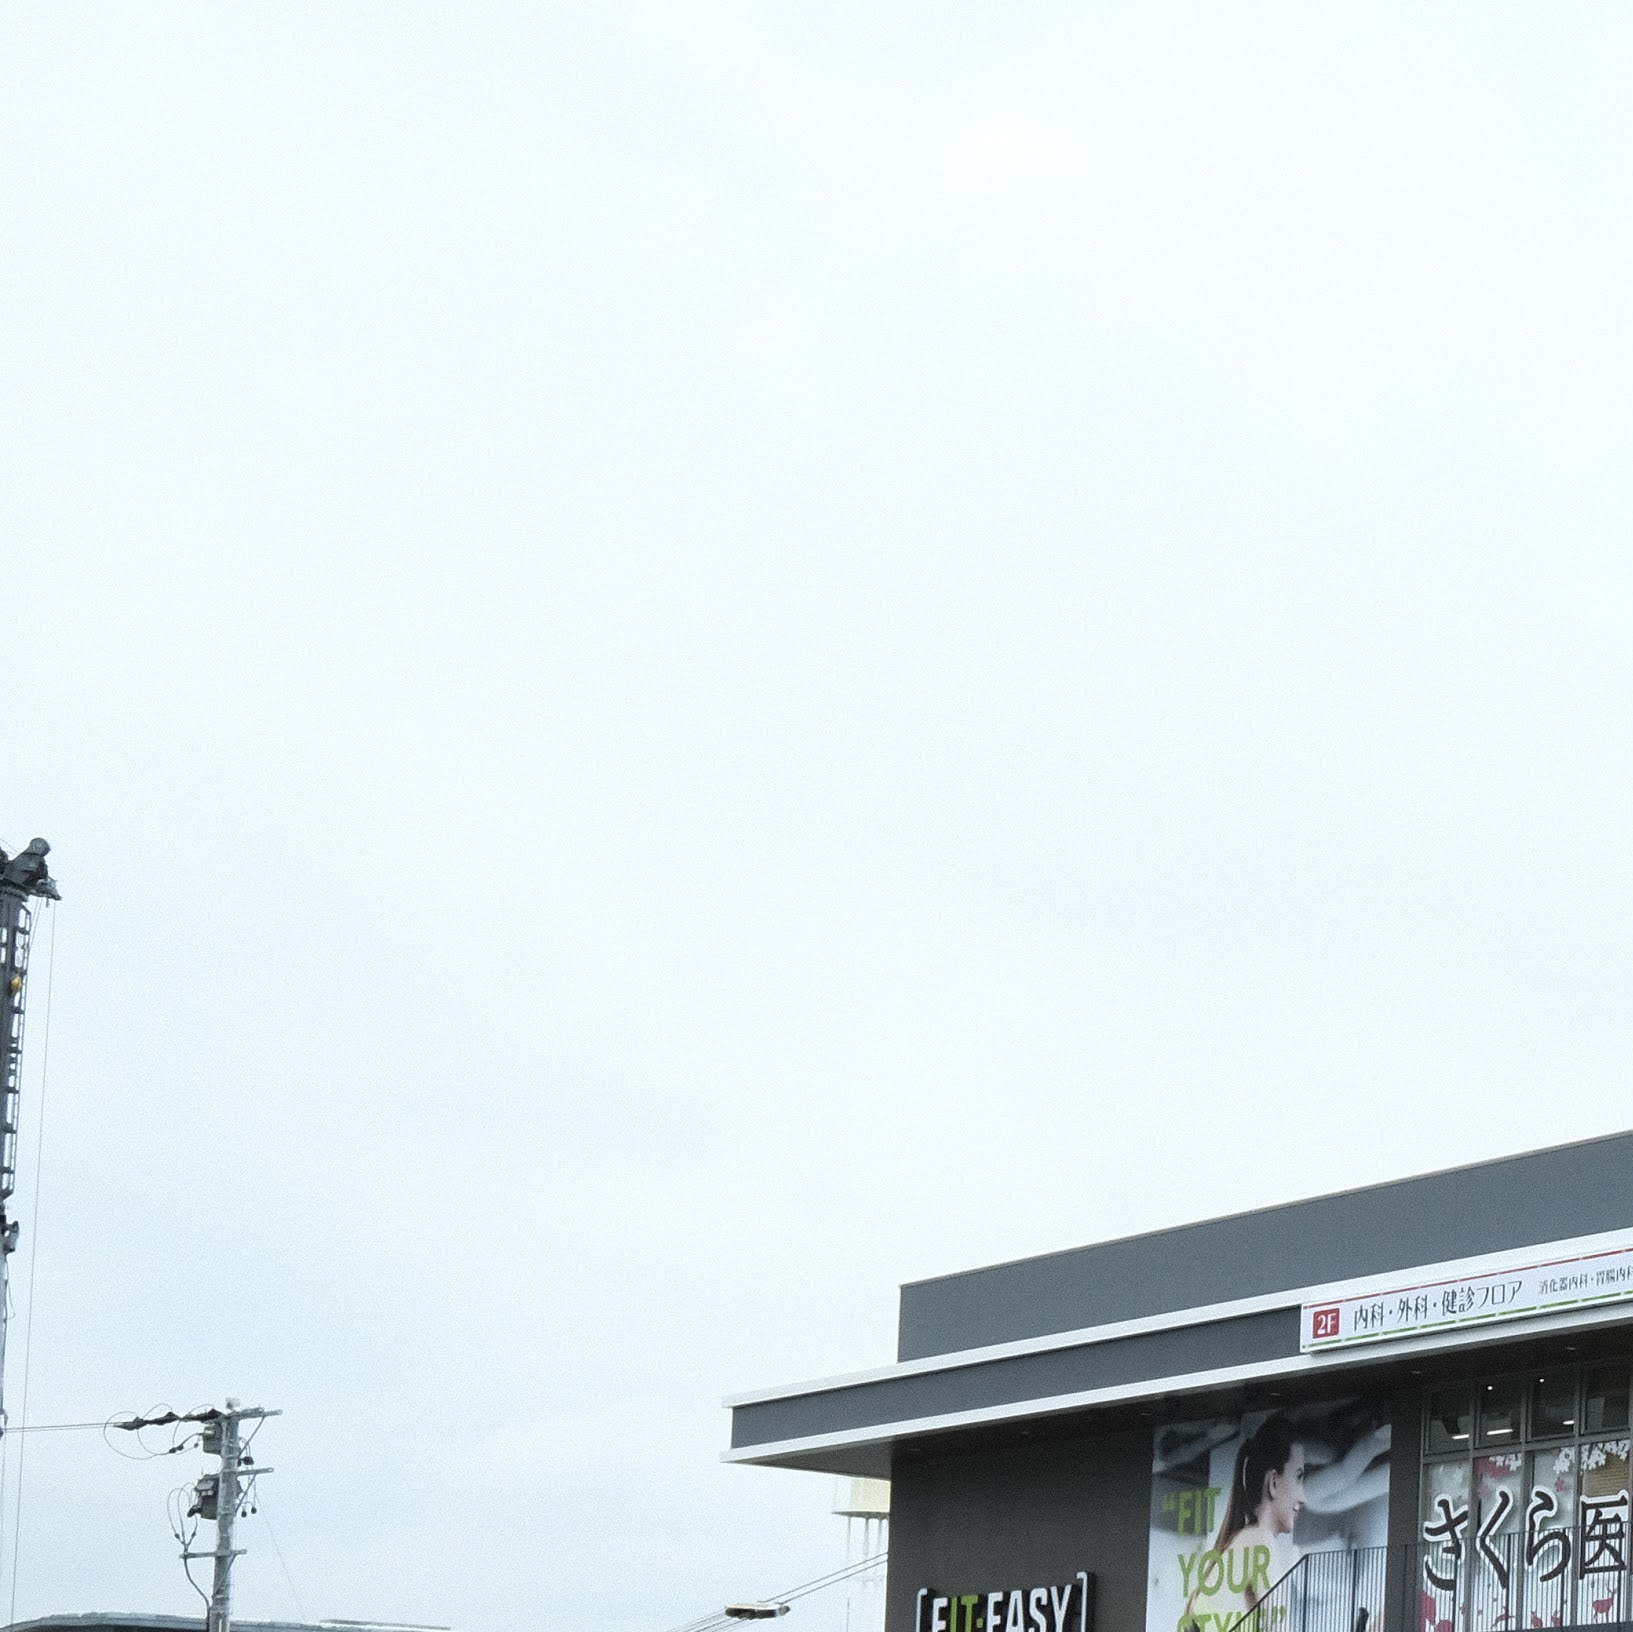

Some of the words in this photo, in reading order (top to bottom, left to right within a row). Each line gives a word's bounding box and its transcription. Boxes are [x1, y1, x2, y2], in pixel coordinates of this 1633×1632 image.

[1317, 1312, 1338, 1335] 2F
[1354, 1281, 1522, 1330] 内科・外科・健診フロア
[1178, 1544, 1271, 1598] YOUR
